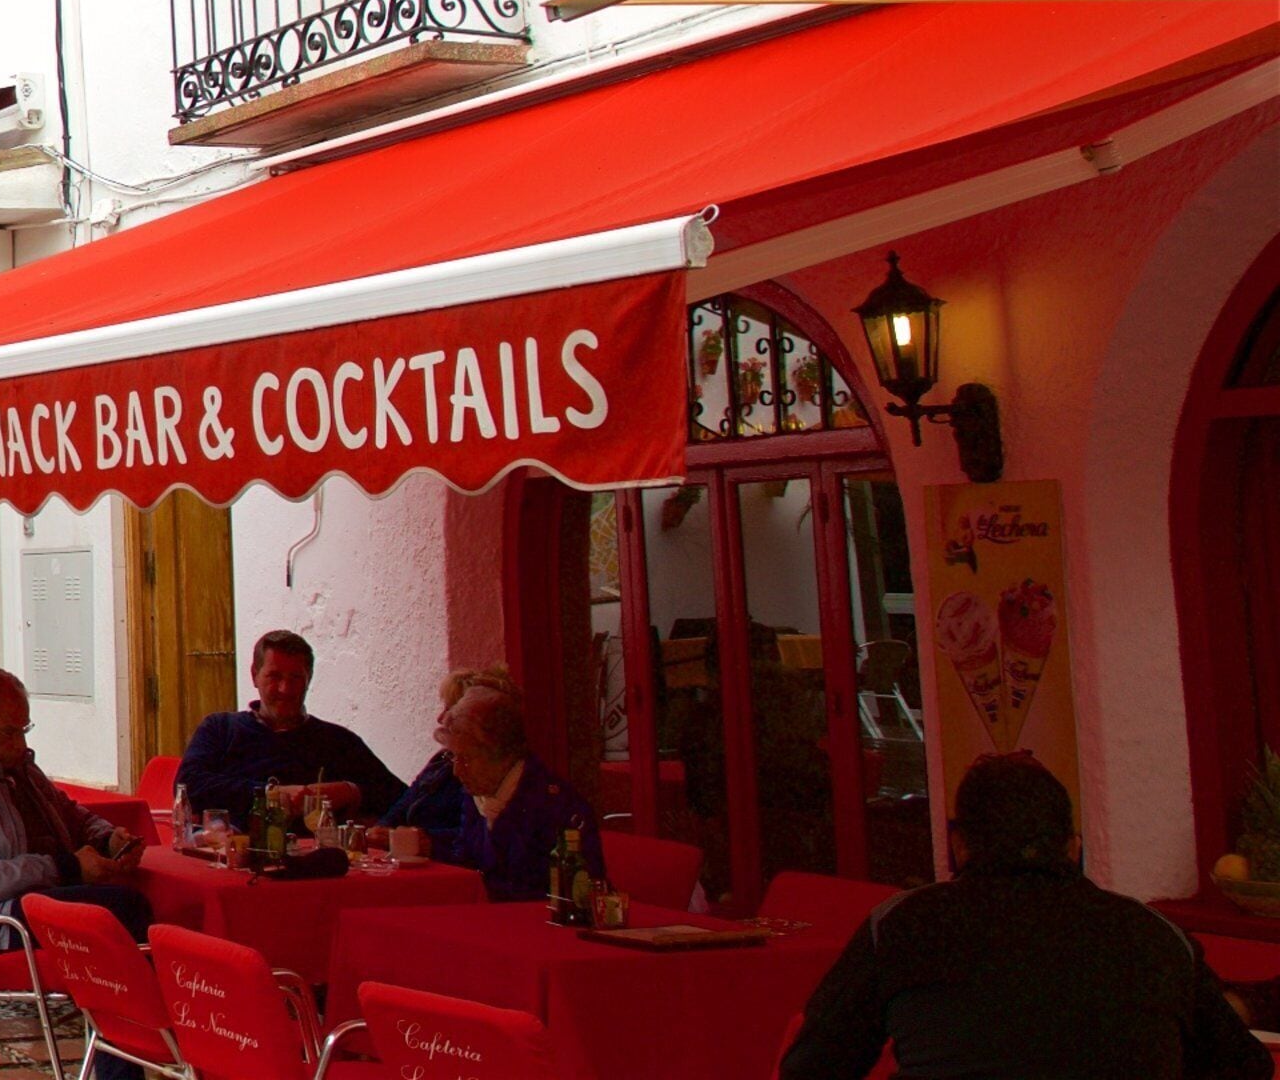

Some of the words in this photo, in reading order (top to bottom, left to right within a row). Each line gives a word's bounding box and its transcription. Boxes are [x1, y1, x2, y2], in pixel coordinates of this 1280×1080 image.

[95, 385, 187, 469] BAR
[198, 386, 235, 460] &
[251, 329, 608, 456] COCKTAILS
[41, 925, 90, 954] Cafeteria
[82, 966, 129, 996] Naranjos
[171, 960, 226, 998] Cafeteria
[201, 1011, 259, 1052] Naranjos
[397, 1019, 482, 1062] Cafeteria
